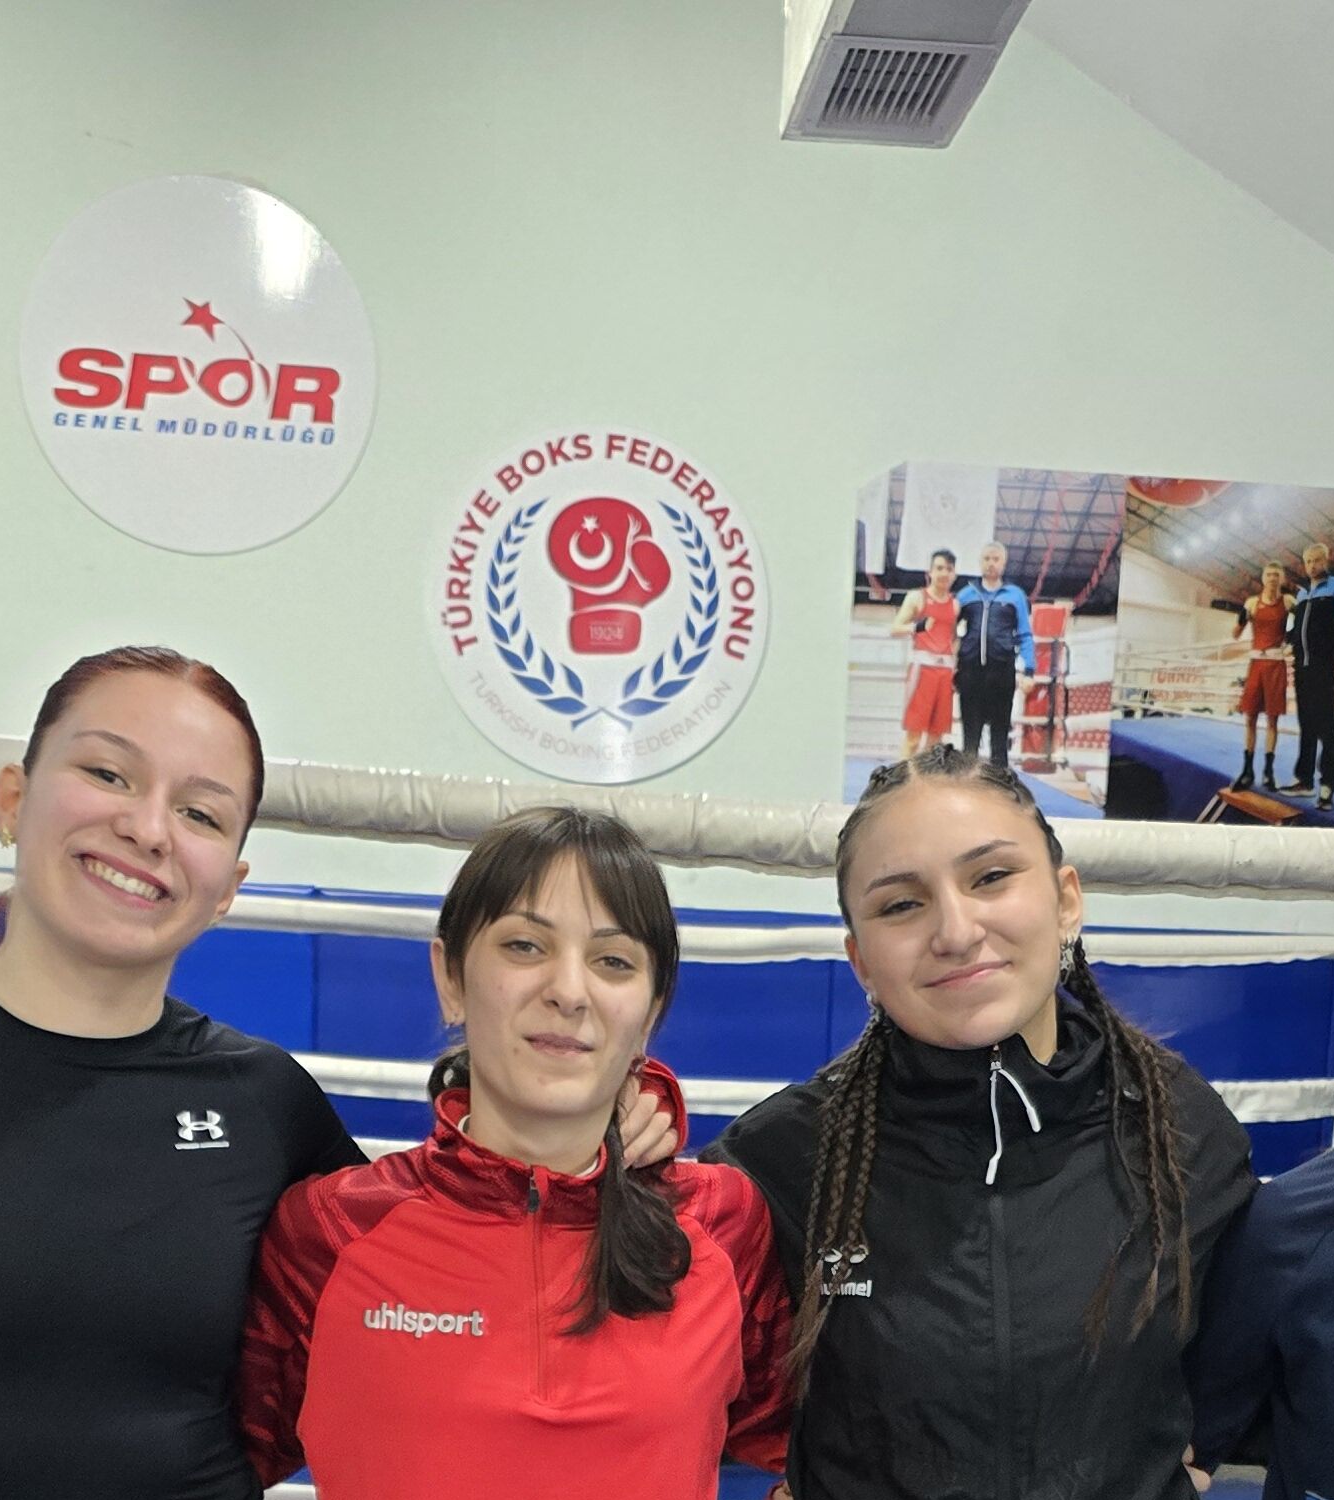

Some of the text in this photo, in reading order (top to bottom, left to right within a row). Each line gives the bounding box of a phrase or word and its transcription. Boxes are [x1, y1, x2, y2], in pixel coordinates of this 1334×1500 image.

[53, 347, 341, 424] SPOR
[53, 412, 335, 446] GENEL MÜDÜRLÜĞÜ
[442, 433, 755, 660] TÜRKİYE BOKS FEDERASYONU
[470, 670, 537, 742] TURKISH
[363, 1302, 484, 1338] uhlsport
